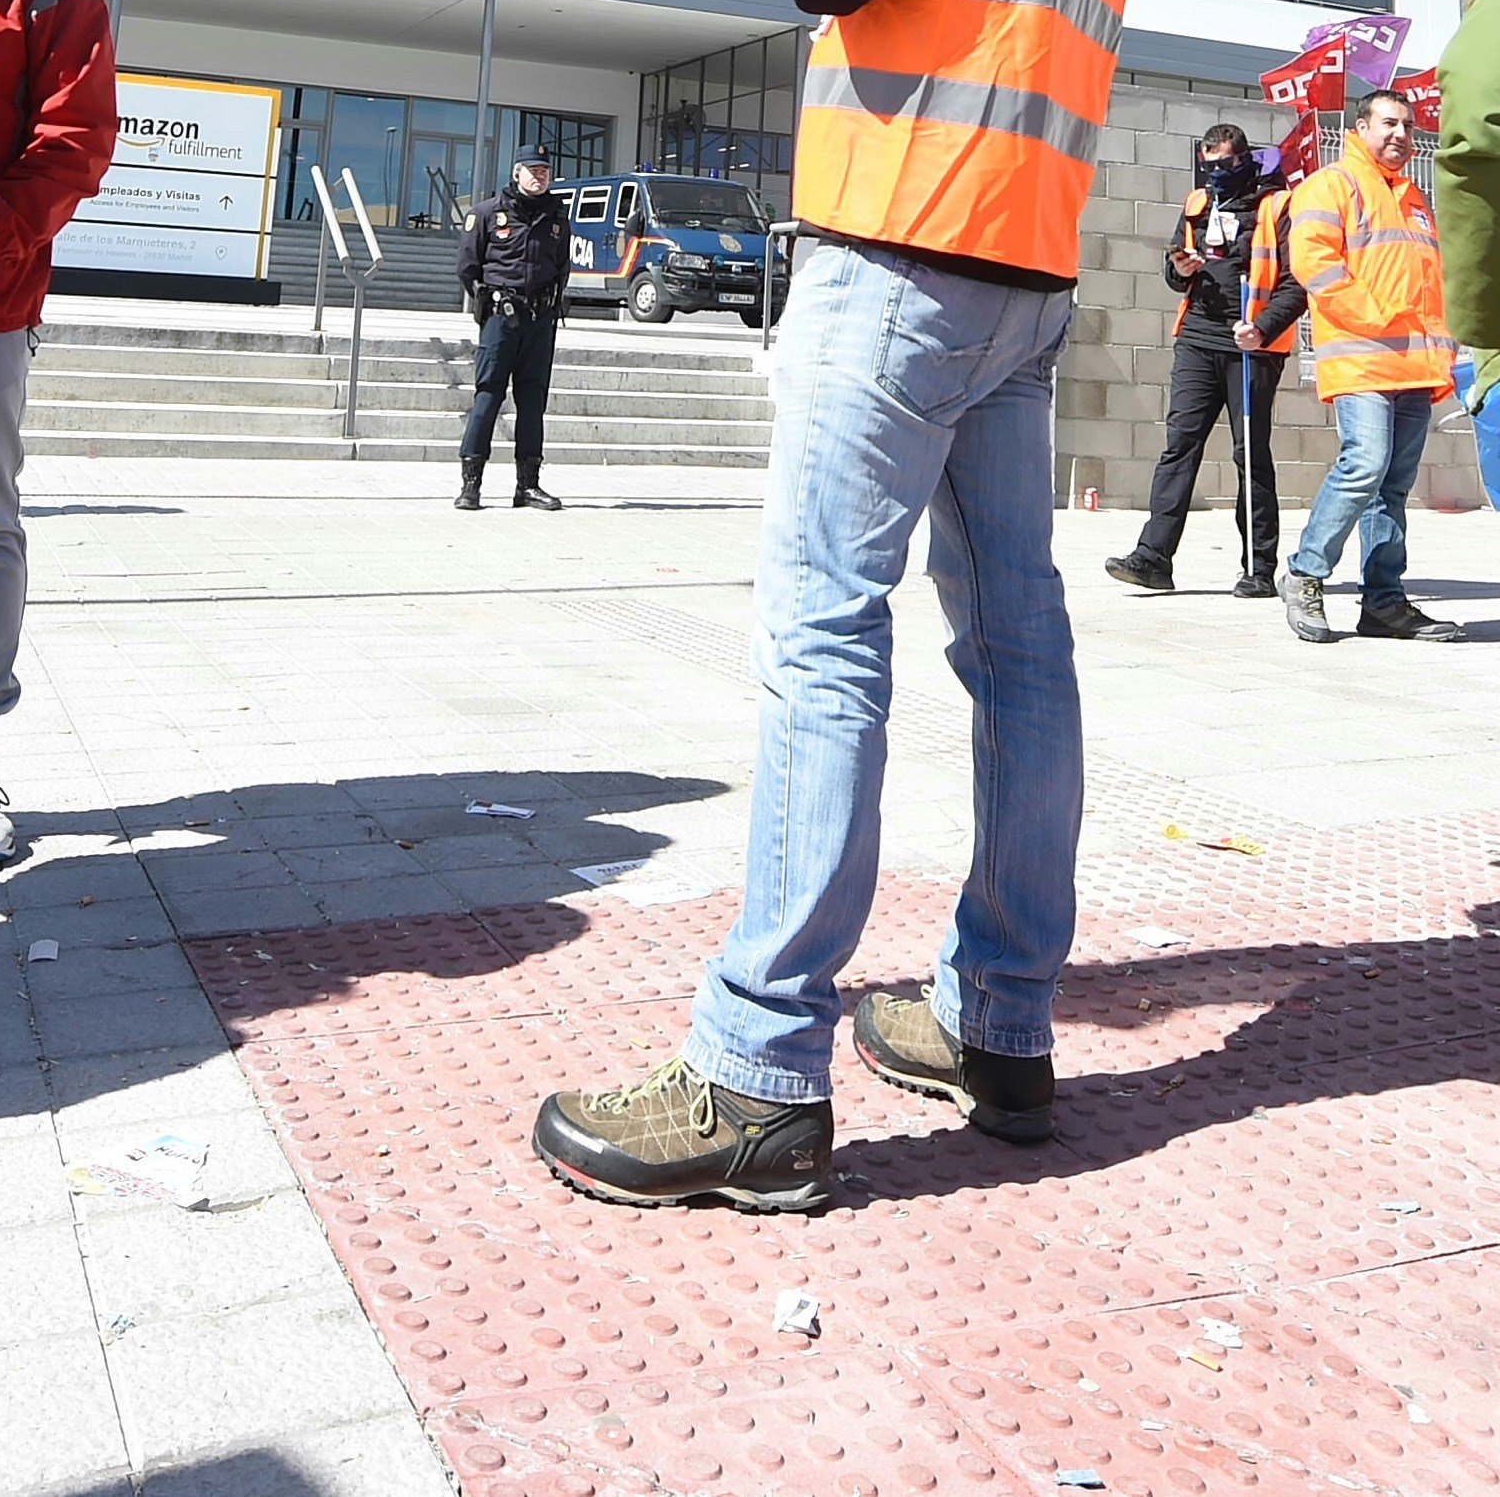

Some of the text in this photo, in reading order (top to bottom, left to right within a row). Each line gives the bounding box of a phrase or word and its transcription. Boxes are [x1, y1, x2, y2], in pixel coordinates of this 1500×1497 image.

[116, 115, 199, 140] mazon
[168, 138, 243, 160] fulfillment
[100, 186, 201, 201] mpleados y Visitas
[80, 233, 93, 242] de
[97, 234, 112, 244] los
[188, 240, 196, 250] 2
[569, 234, 594, 270] ICIA
